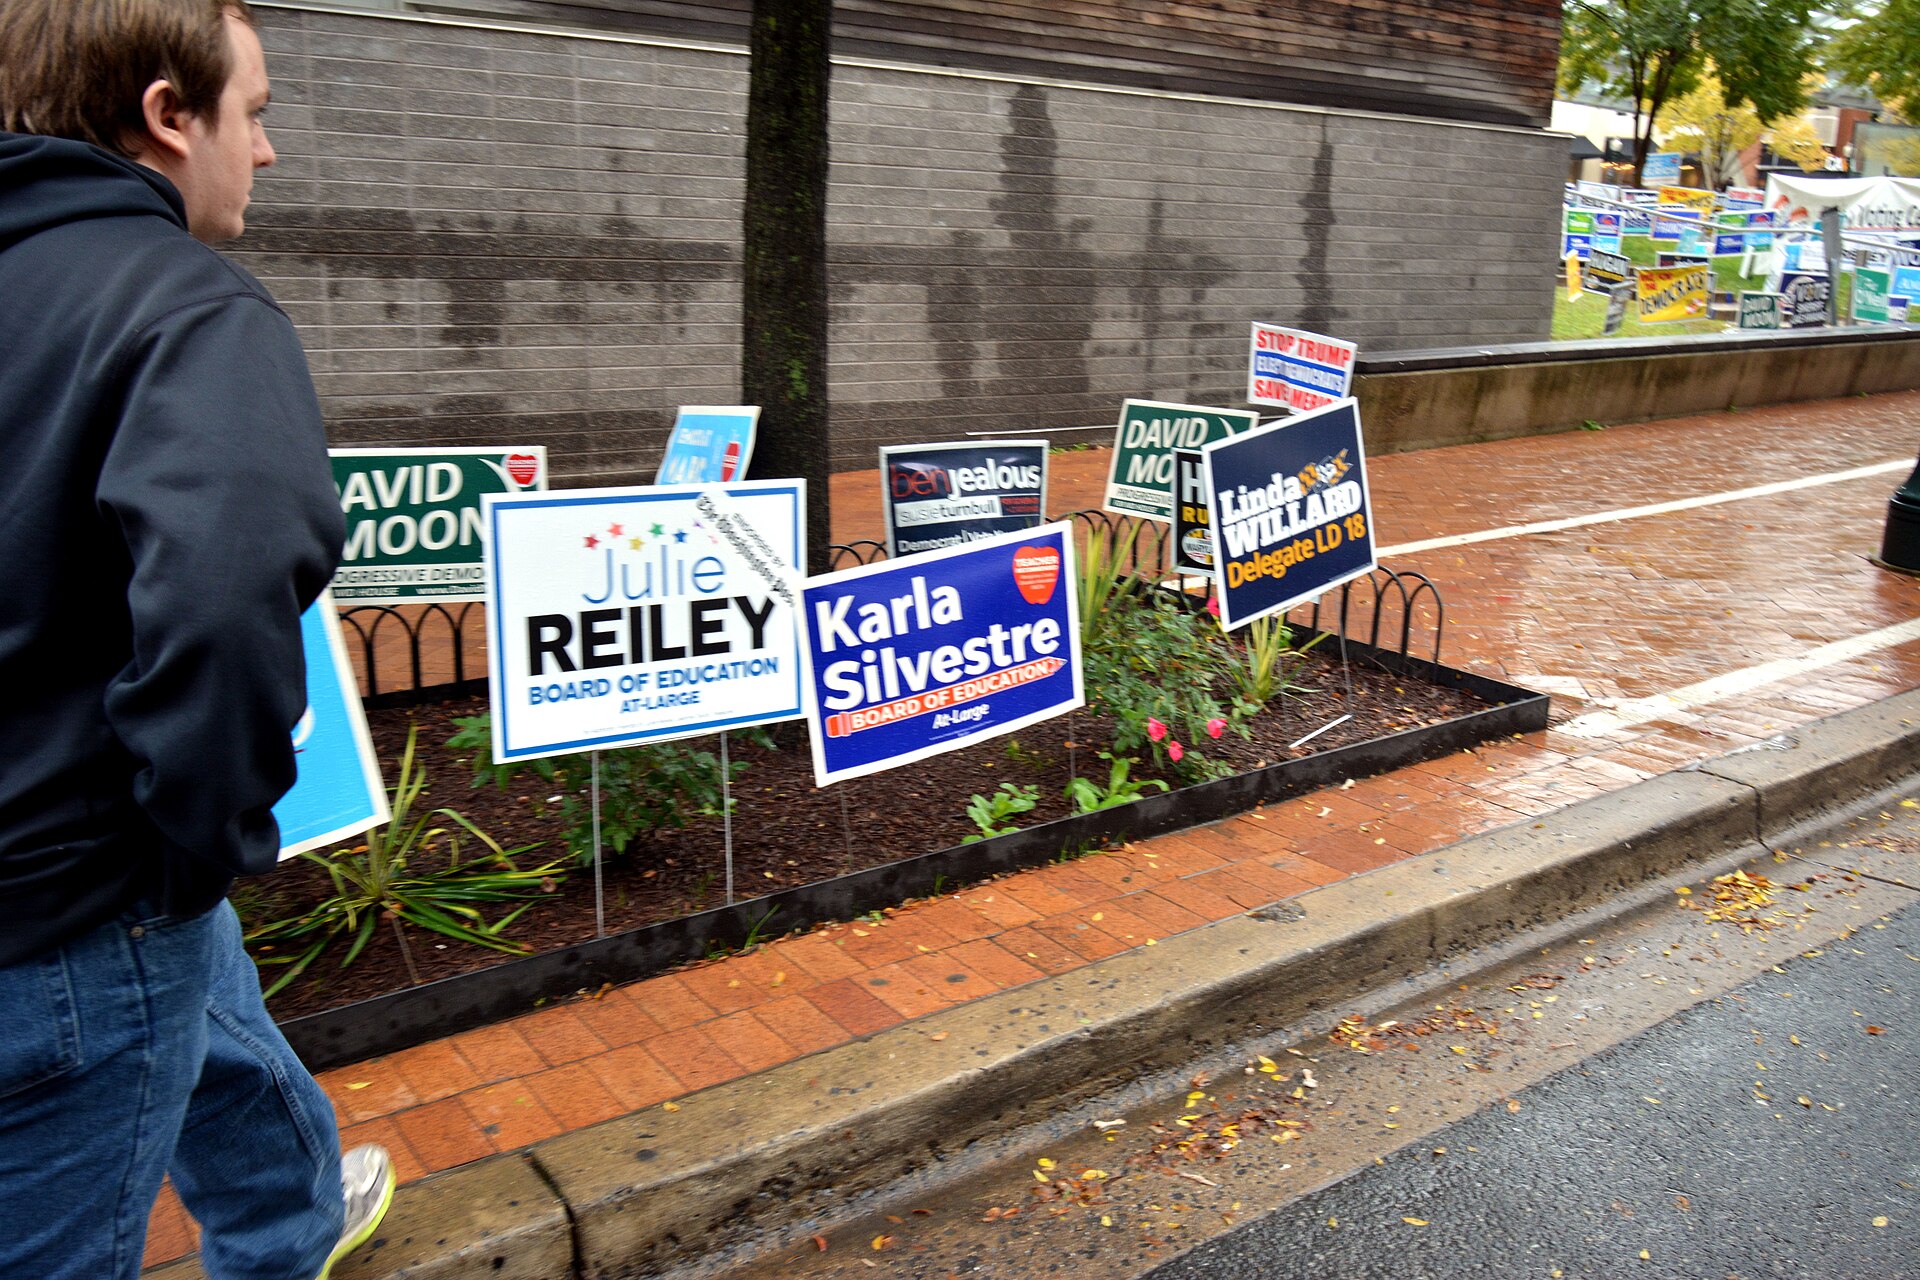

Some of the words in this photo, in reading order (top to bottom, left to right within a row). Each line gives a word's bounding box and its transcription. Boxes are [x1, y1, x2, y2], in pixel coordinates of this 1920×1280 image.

[1256, 330, 1295, 352] STOP
[1298, 338, 1351, 367] TRUMP
[1124, 416, 1209, 449] DAVID
[334, 462, 463, 513] AVID
[1218, 472, 1303, 526] Linda
[1222, 480, 1362, 558] WILLARD
[583, 544, 725, 604] Julie
[1226, 538, 1315, 589] Delegate
[1315, 523, 1343, 553] LD
[1343, 513, 1366, 541] 18
[527, 595, 775, 677] REILEY
[815, 576, 963, 653] Karla
[529, 678, 611, 705] BOARD
[618, 673, 650, 694] OF
[656, 656, 779, 689] EDUCATION
[823, 617, 1061, 711] Silvestre
[620, 690, 701, 713] AT-LARGE
[852, 695, 921, 729] BOARD
[923, 691, 951, 710] OF
[953, 664, 1050, 702] EDUCATION
[932, 703, 990, 729] At-Large
